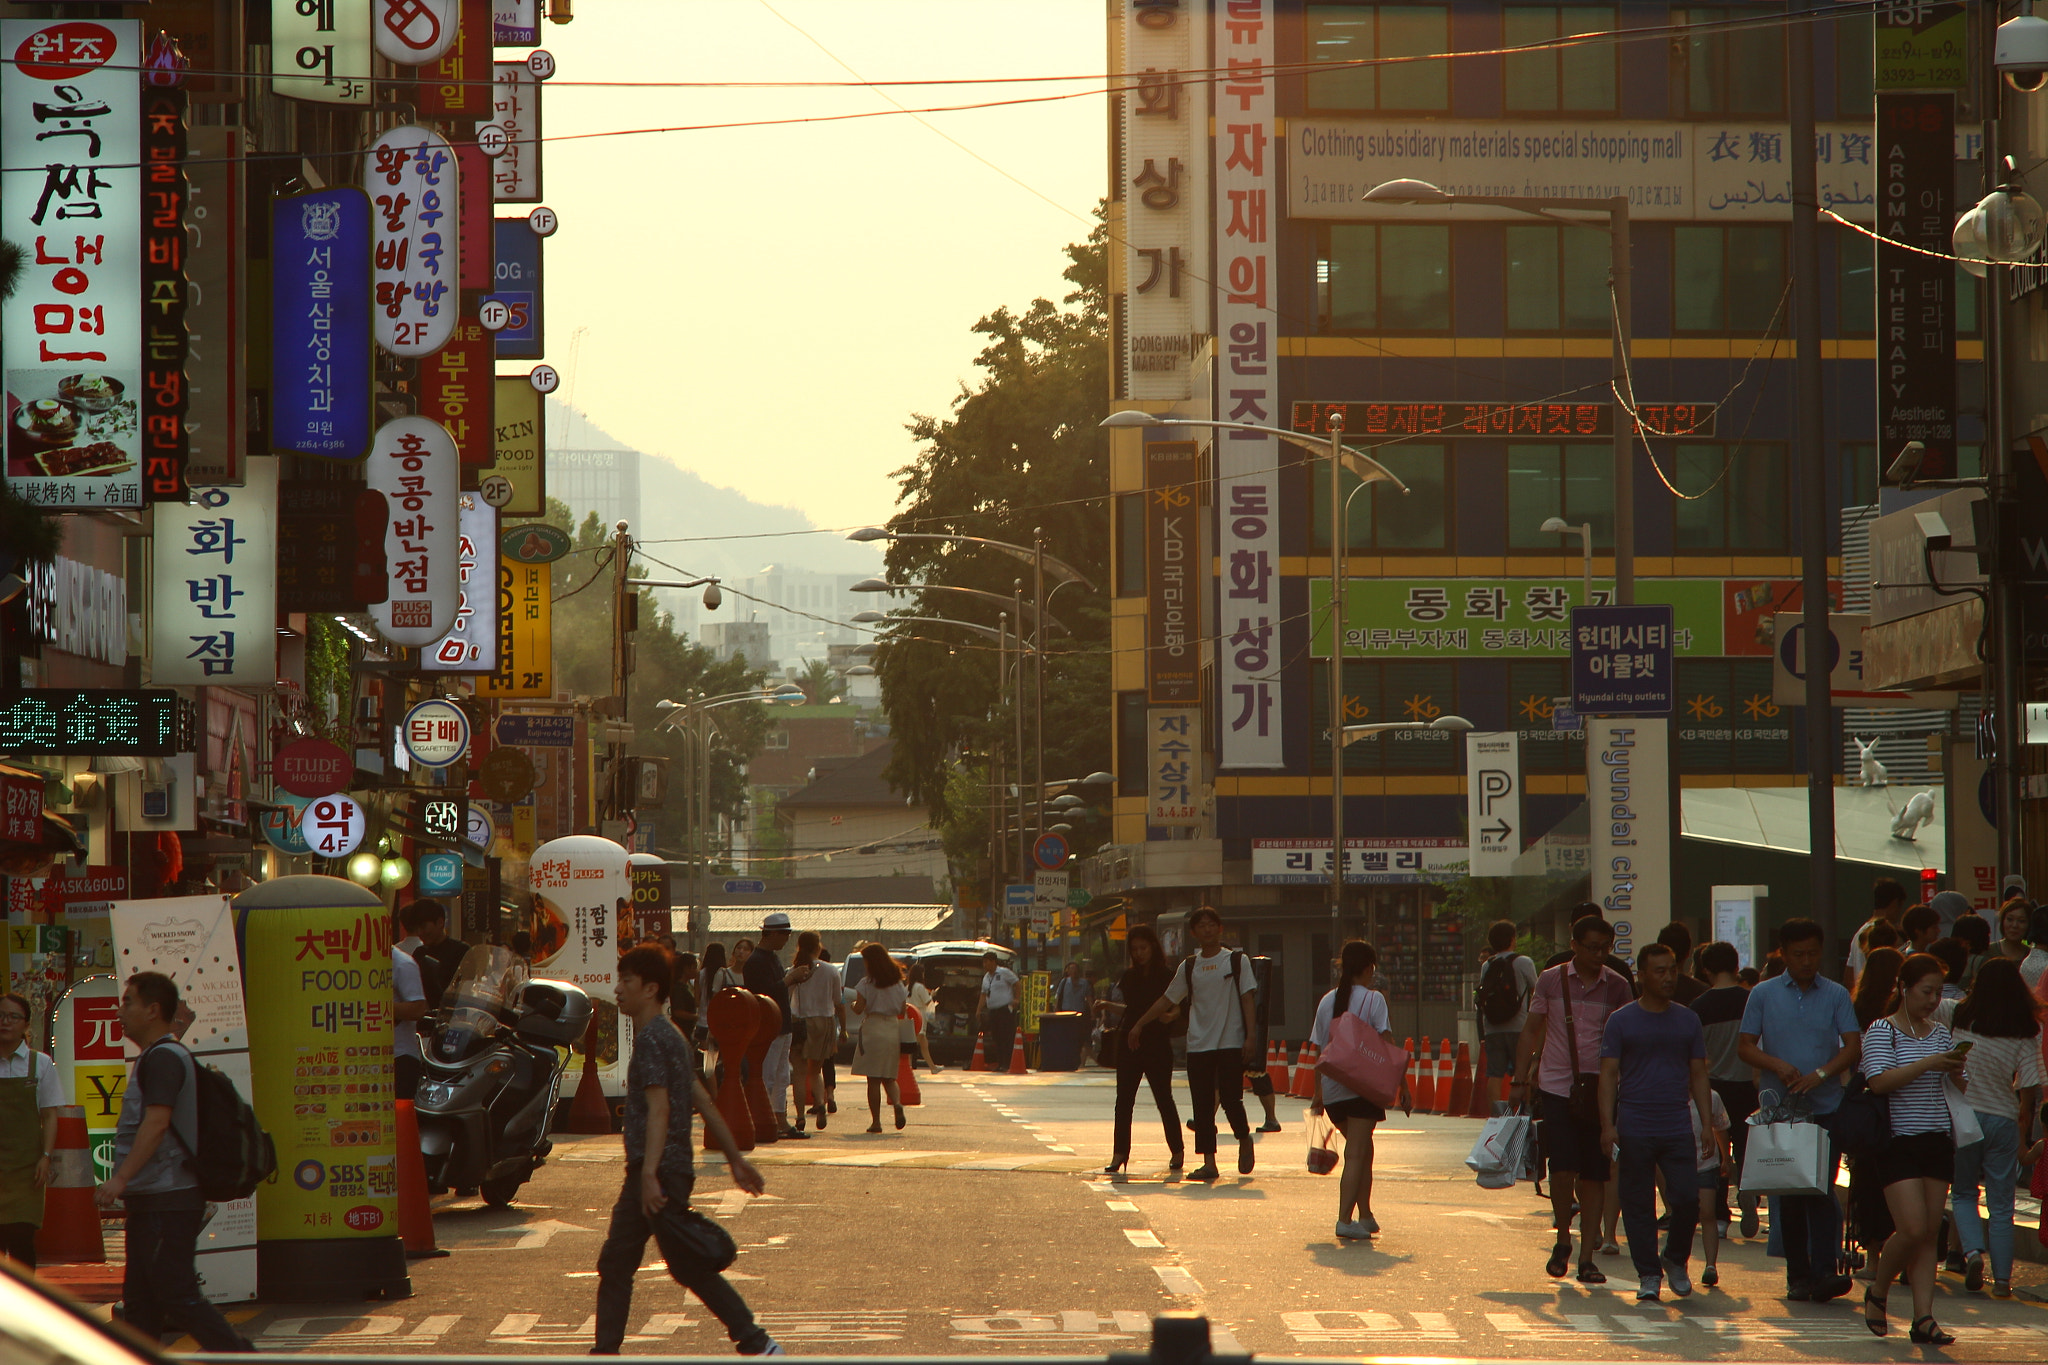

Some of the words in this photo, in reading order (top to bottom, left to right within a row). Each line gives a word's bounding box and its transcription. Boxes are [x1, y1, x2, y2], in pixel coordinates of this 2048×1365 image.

[30, 33, 103, 64] 원조
[531, 56, 551, 70] B1
[1882, 68, 1962, 82] 3393-1293
[339, 80, 364, 99] 3F
[483, 134, 502, 148] 1F
[1301, 127, 1365, 162] Clothing
[1367, 128, 1446, 163] subsidiary
[1448, 129, 1521, 159] materials
[1523, 129, 1579, 164] special
[1580, 129, 1650, 164] shopping
[1652, 129, 1683, 159] mall
[1302, 175, 1354, 204] Здание
[1888, 144, 1906, 236] AROMA
[375, 143, 411, 318] 왕갈비탕
[413, 141, 449, 317] 한우국밥
[534, 214, 551, 228] 1F
[1920, 187, 1944, 264] 아로마
[149, 280, 180, 360] 주는
[484, 308, 503, 322] 1F
[1921, 278, 1945, 353] 테라피
[306, 246, 335, 413] 서울삼성치과
[394, 322, 429, 345] 2F
[1889, 269, 1907, 399] THERAPY
[1131, 354, 1179, 372] MARKET
[535, 372, 553, 386] 1F
[1293, 403, 1348, 433] 나염
[1366, 403, 1447, 434] 열재단
[1891, 406, 1945, 421] Aesthetic
[148, 371, 180, 493] 냉면집
[306, 420, 333, 436] 의원
[104, 484, 138, 504] 冷面
[486, 484, 507, 499] 2F
[389, 433, 434, 593] 홍콩반점
[523, 568, 540, 620] 프리모
[1162, 516, 1185, 657] KB국민은행
[394, 614, 430, 626] 0410
[1228, 484, 1273, 737] 동화상가
[1344, 627, 1469, 650] 의류부자재
[1577, 624, 1667, 650] 현대시티
[1589, 653, 1655, 680] 아울렛
[522, 672, 544, 689] 2F
[1578, 692, 1614, 704] Hyundai
[1616, 692, 1633, 704] city
[1634, 692, 1666, 702] outlets
[411, 720, 459, 743] 담배
[413, 744, 457, 753] CIGARETTES
[283, 757, 342, 773] ETUDE
[1157, 714, 1191, 805] 자수상가
[291, 774, 333, 783] HOUSE
[1602, 728, 1638, 846] Hyundai
[7, 785, 40, 817] 닭강정
[1478, 769, 1512, 816] P
[314, 801, 354, 838] 약
[1156, 806, 1197, 819] 3.4.5F
[318, 834, 349, 853] 4F
[1480, 833, 1491, 844] in
[434, 864, 449, 872] TAX
[547, 879, 569, 888] 0410
[1037, 876, 1067, 887] 견인지역
[1603, 856, 1638, 911] city
[588, 903, 608, 948] 짬뽕
[202, 980, 239, 991] WICKED
[302, 970, 362, 991] FOOD
[572, 973, 612, 985] 4,500원
[83, 1005, 124, 1049] 元
[330, 1164, 365, 1184] SBS
[226, 1200, 254, 1211] BERRY
[304, 1212, 333, 1228] 지하
[348, 1211, 381, 1226] 地下B1
